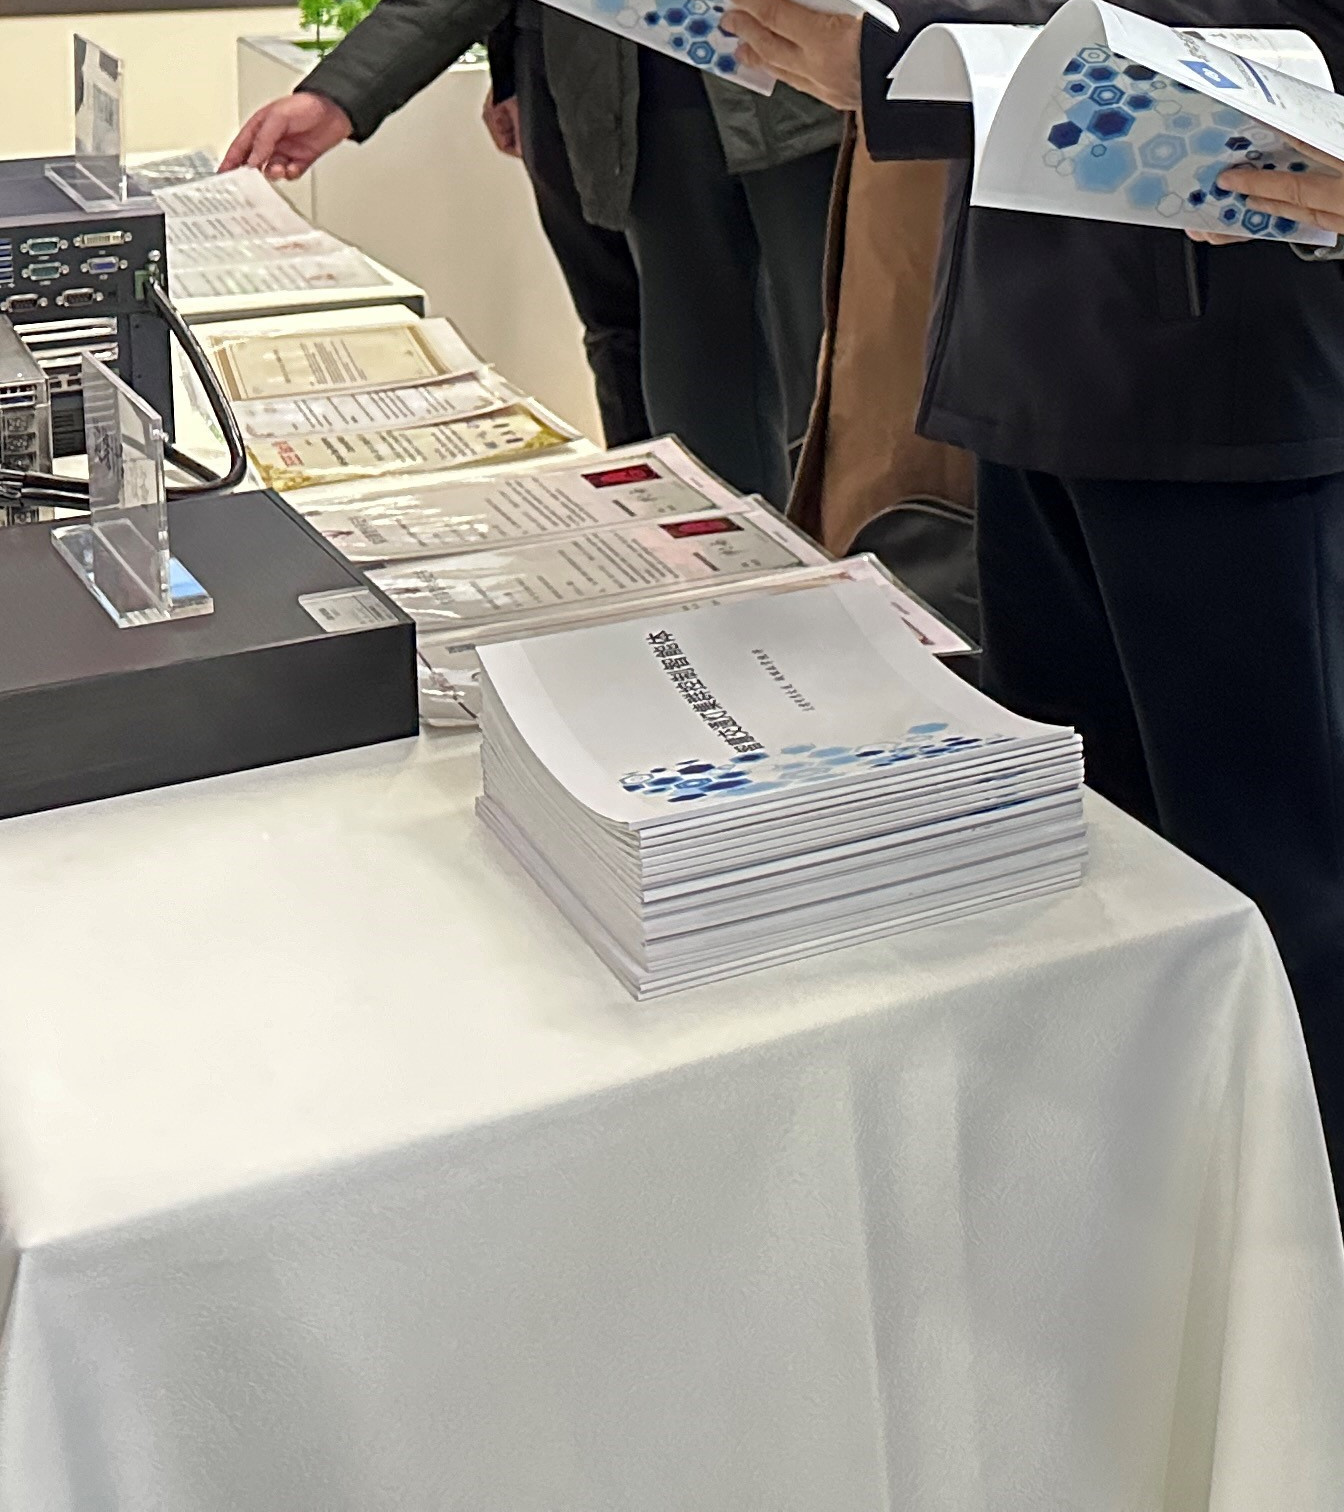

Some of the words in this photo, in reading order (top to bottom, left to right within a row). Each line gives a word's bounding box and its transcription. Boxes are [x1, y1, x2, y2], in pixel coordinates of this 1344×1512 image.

[646, 629, 766, 754] 智慧交通灯集群控制智能体
